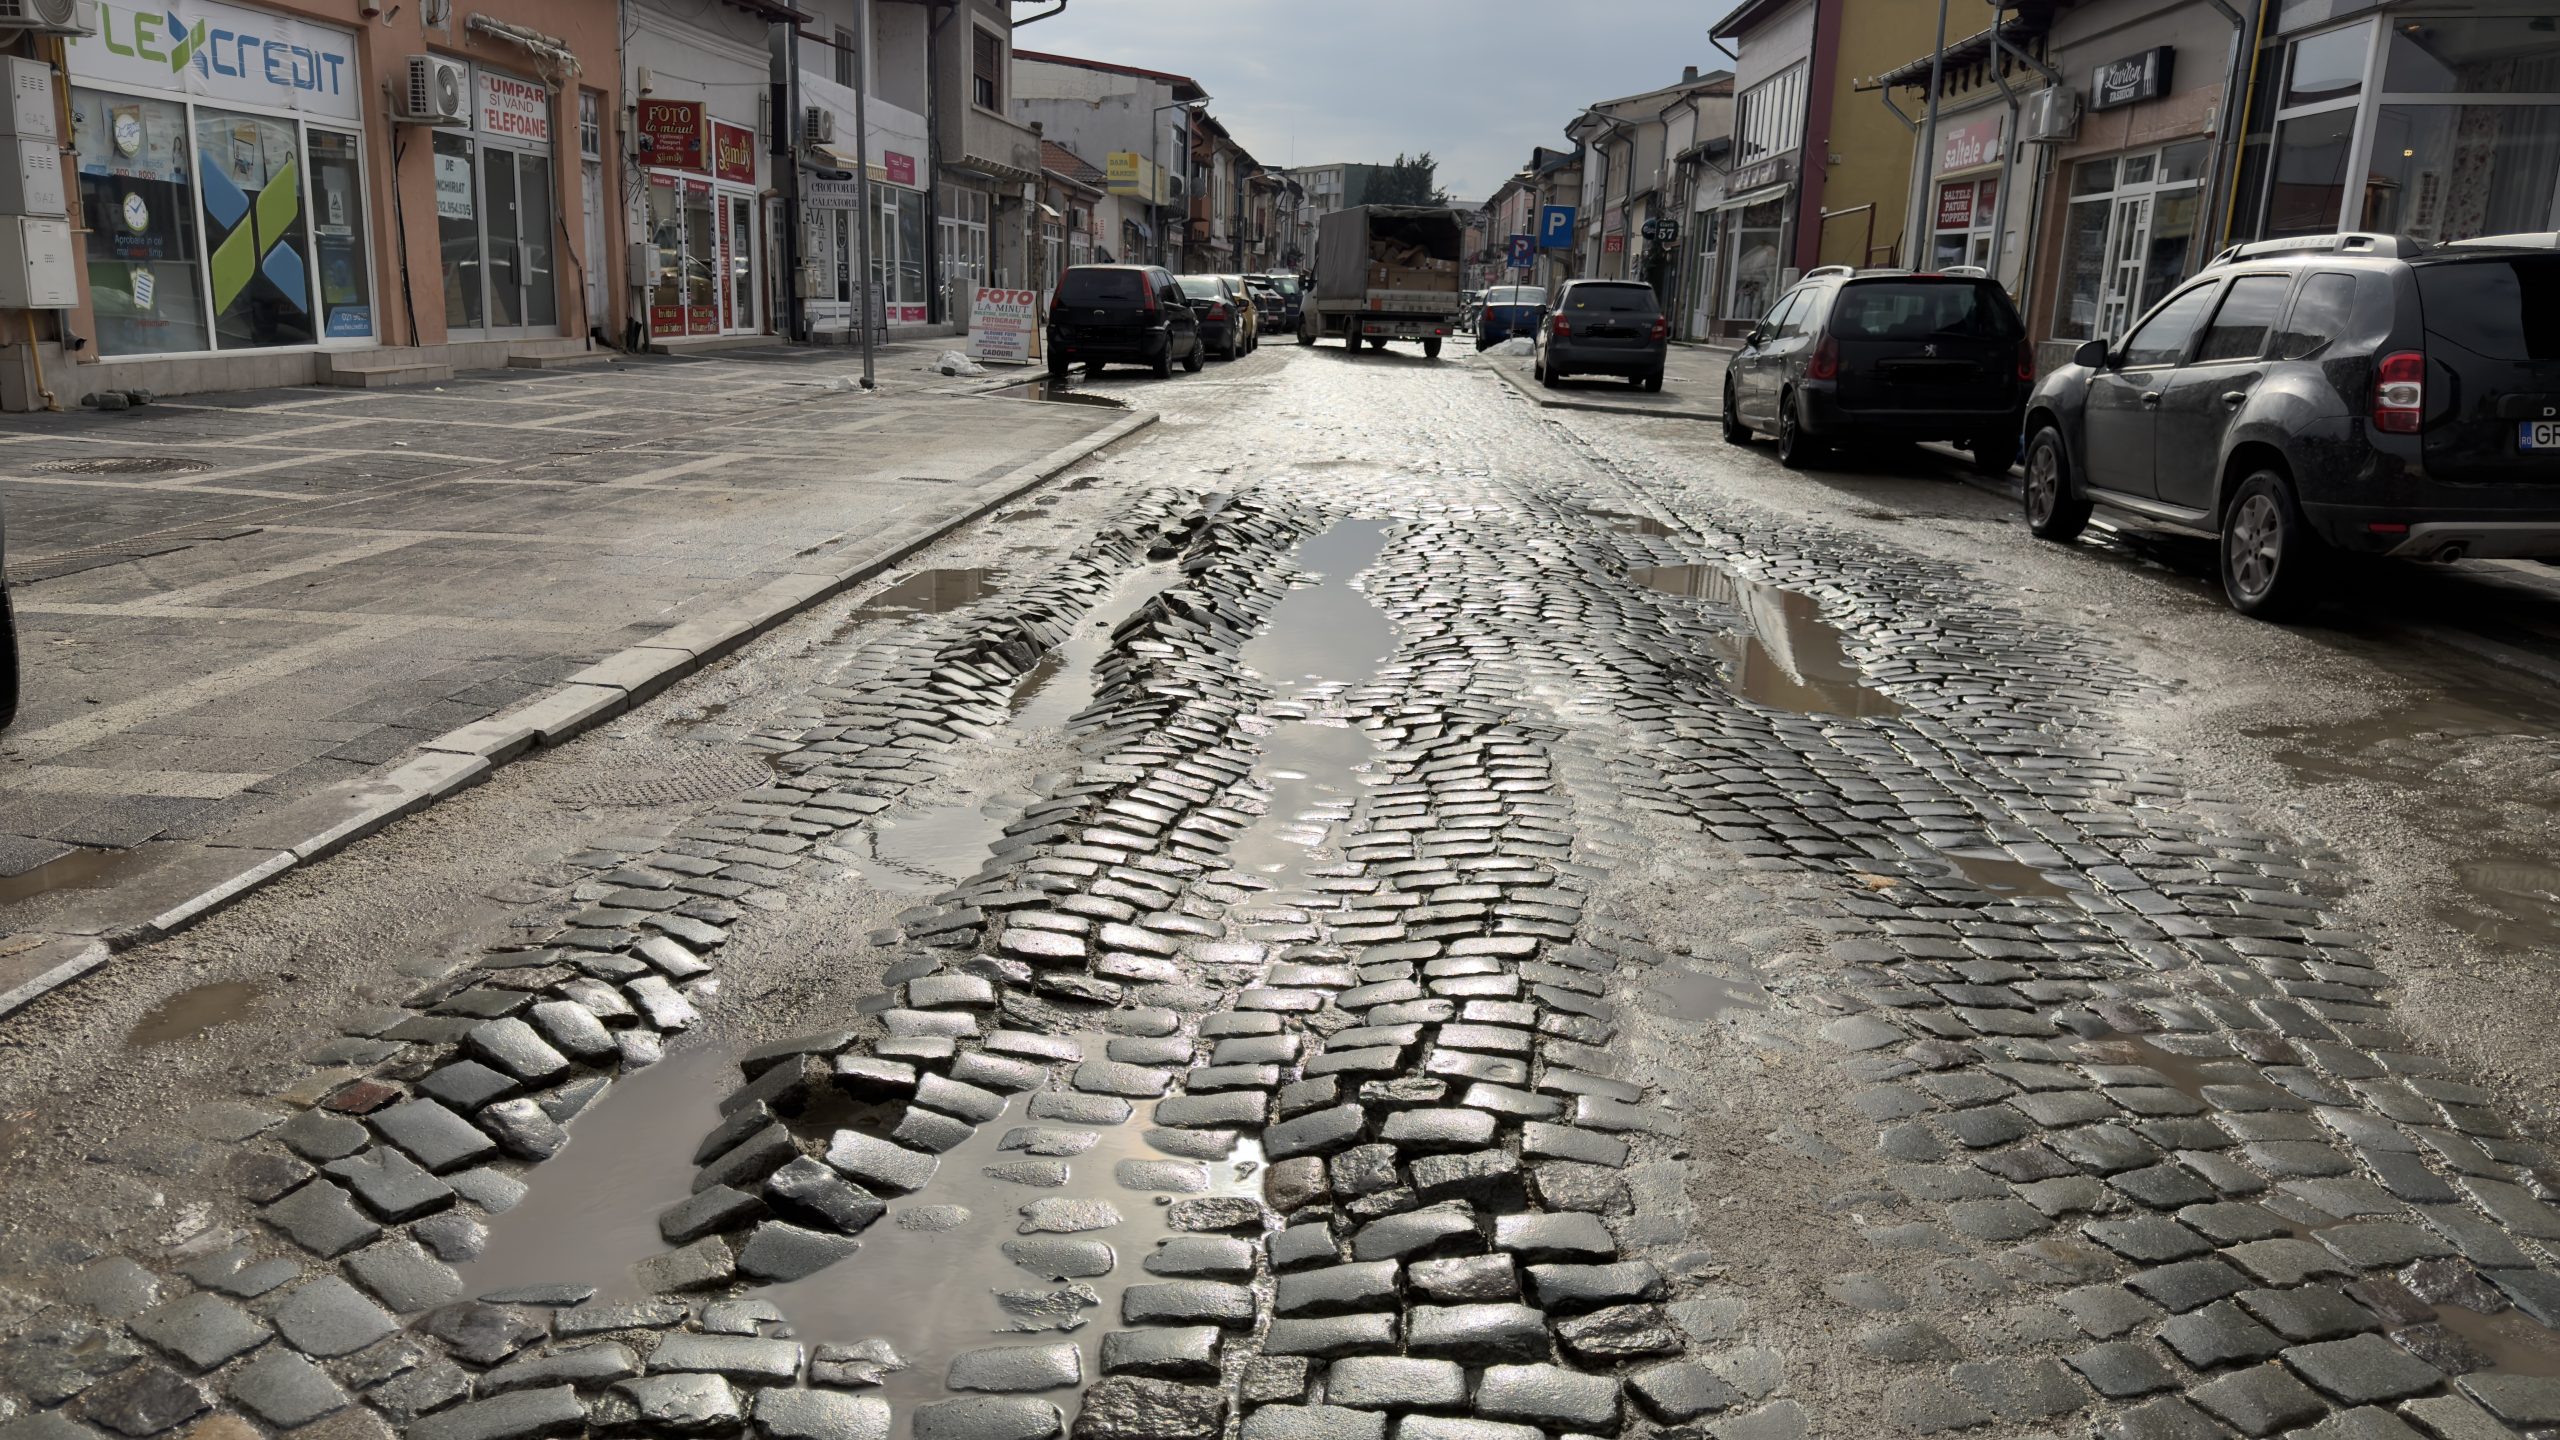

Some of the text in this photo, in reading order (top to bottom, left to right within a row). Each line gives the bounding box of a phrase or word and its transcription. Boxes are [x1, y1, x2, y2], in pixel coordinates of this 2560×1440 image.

[479, 75, 545, 103] CUMPAR
[2109, 87, 2135, 102] FASHION
[504, 96, 534, 113] VAND
[649, 106, 691, 123] FOTO
[485, 108, 546, 138] ELEFOANE
[660, 122, 694, 135] minut
[1945, 136, 1980, 168] saltele
[446, 159, 455, 171] DE
[1944, 189, 1971, 200] SALTELE
[1945, 200, 1968, 212] PATURI
[1548, 212, 1566, 236] P
[1941, 212, 1969, 223] TOPPERE
[1658, 229, 1674, 239] 57
[1515, 240, 1528, 257] P
[1608, 242, 1620, 252] 53
[976, 288, 1034, 305] FOTO
[978, 303, 1029, 313] LA MINUT
[982, 349, 1013, 357] CADOURI
